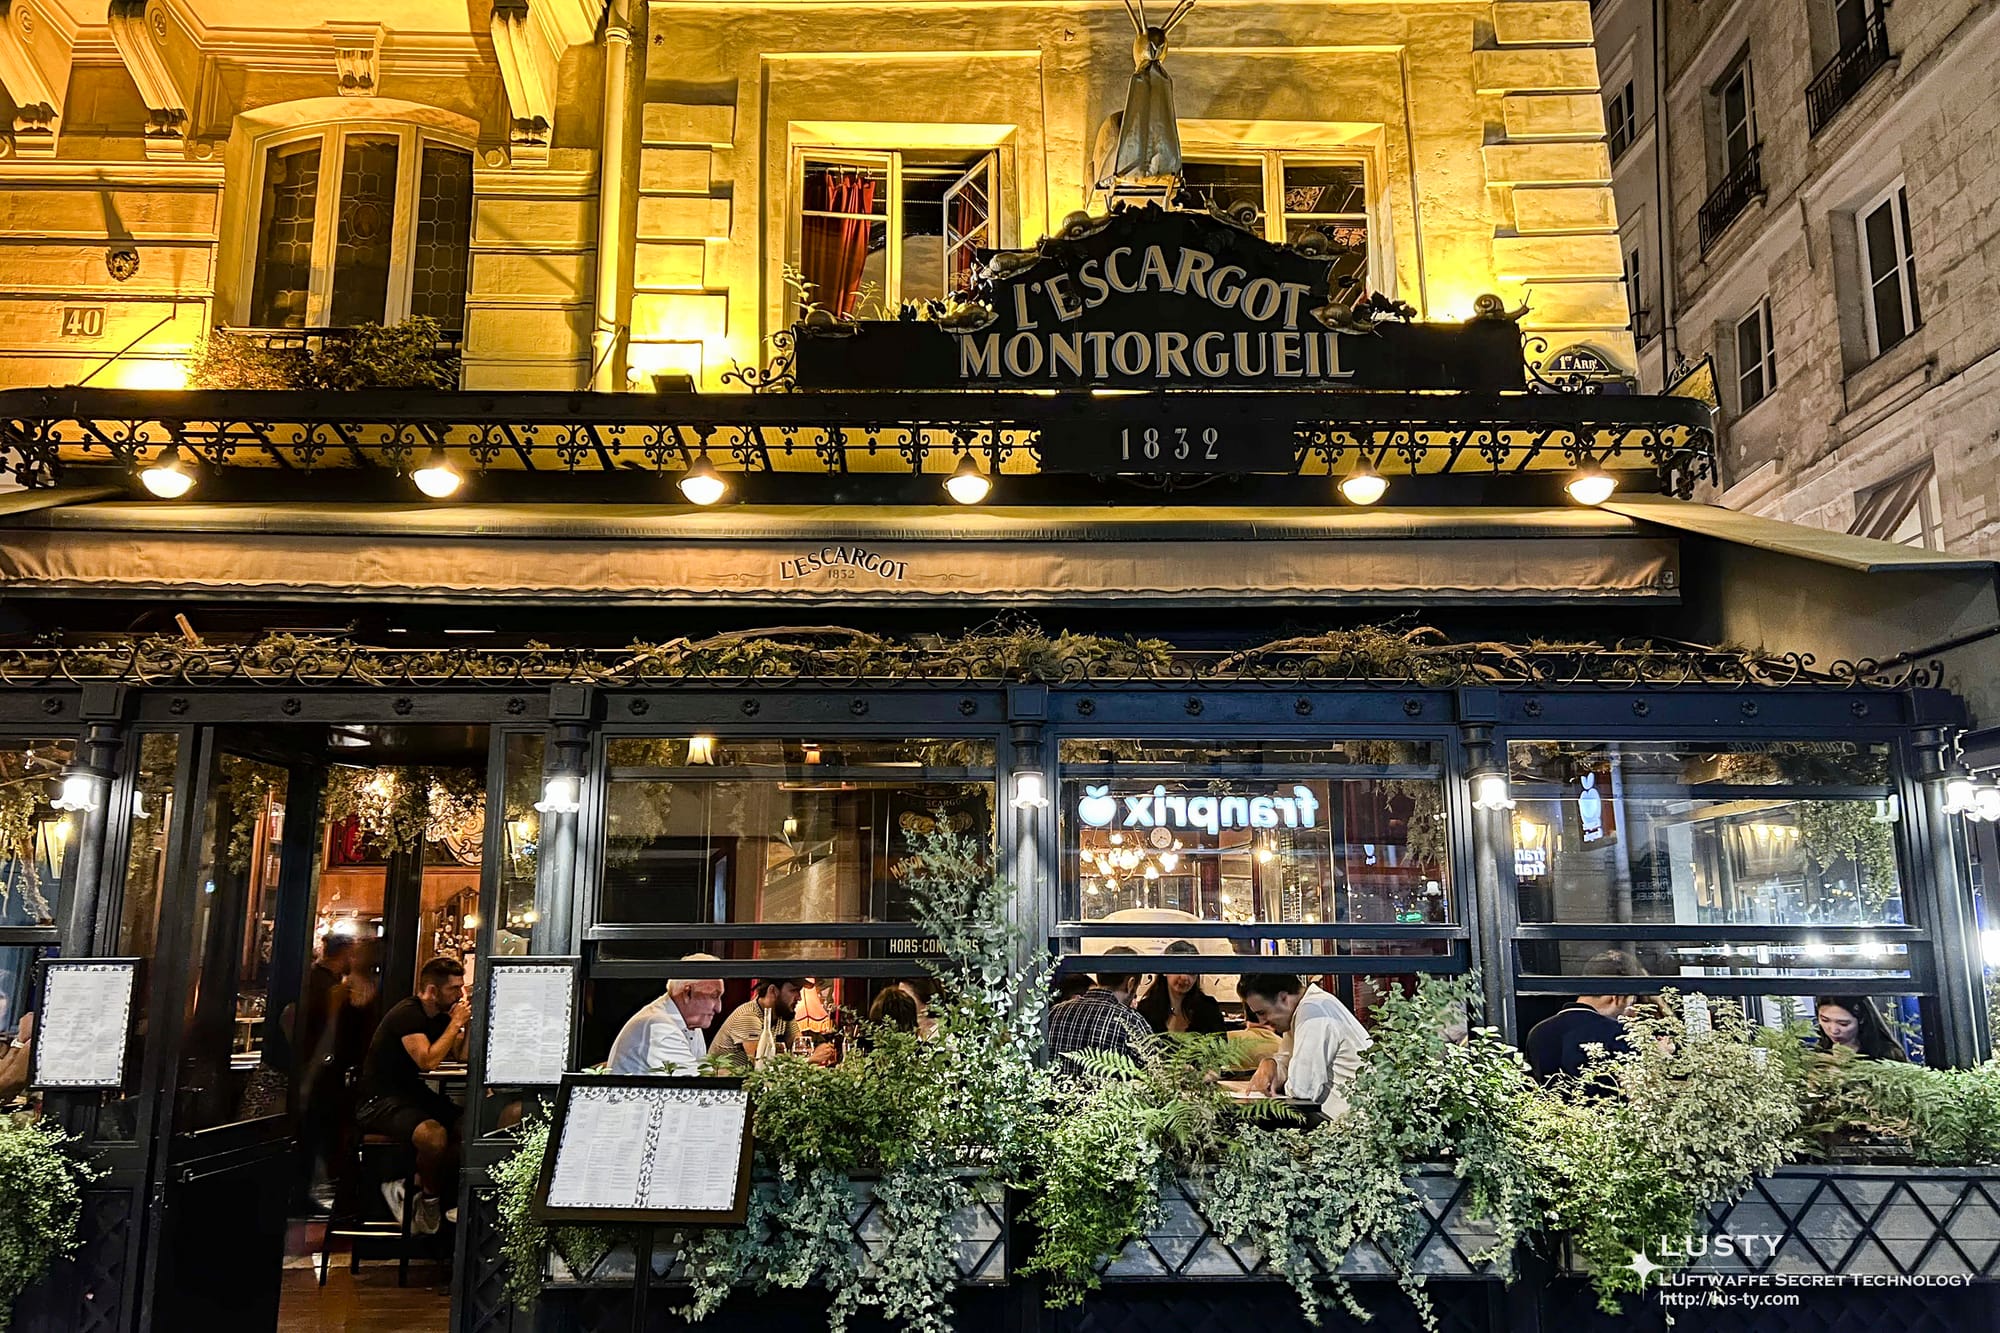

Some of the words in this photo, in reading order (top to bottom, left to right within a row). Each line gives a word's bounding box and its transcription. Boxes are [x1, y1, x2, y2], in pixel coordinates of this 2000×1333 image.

[1013, 245, 1311, 331] L'ESCARGOT
[66, 309, 101, 335] 40
[959, 331, 1355, 378] MONTORGUEIL
[1562, 385, 1596, 395] RE
[1120, 427, 1218, 460] 1832
[780, 546, 908, 581] L'ESCARGOT
[828, 569, 855, 579] 1832
